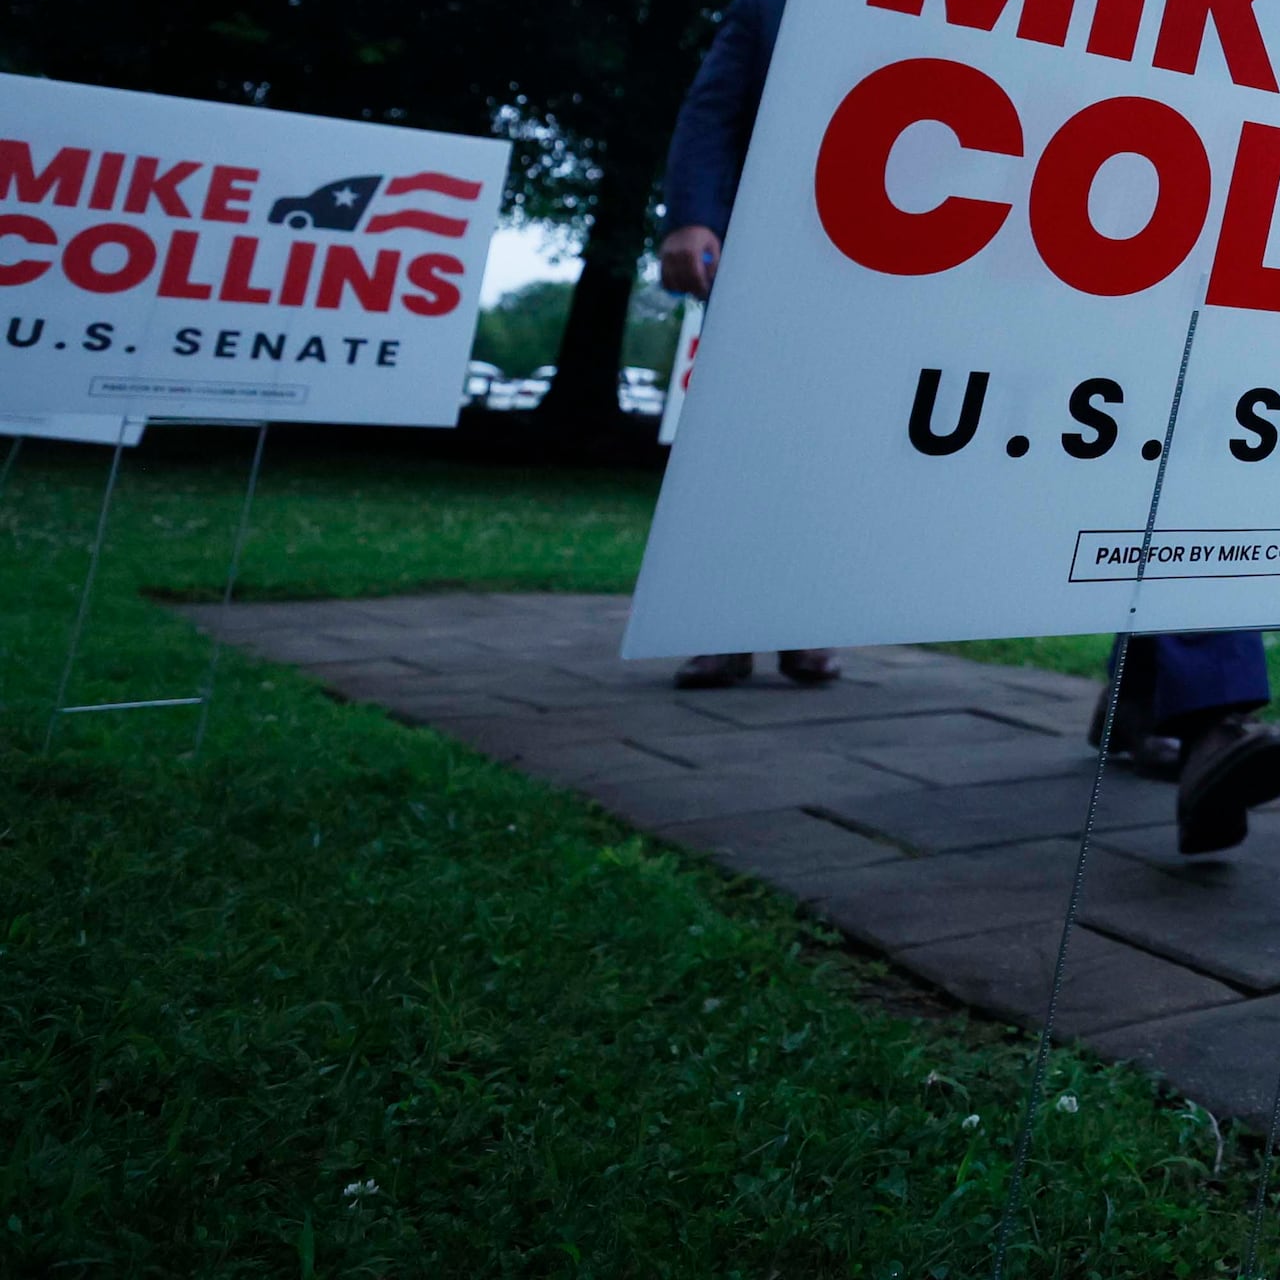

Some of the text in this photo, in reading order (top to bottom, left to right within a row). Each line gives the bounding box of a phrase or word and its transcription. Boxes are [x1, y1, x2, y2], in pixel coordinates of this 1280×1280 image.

[0, 139, 260, 223] MIKE
[6, 317, 400, 366] U.S. SENATE
[907, 368, 1163, 461] U.S.
[1095, 547, 1144, 565] PAID
[1147, 546, 1185, 563] FOR
[1189, 545, 1215, 562] BY
[1218, 545, 1262, 561] MIKE
